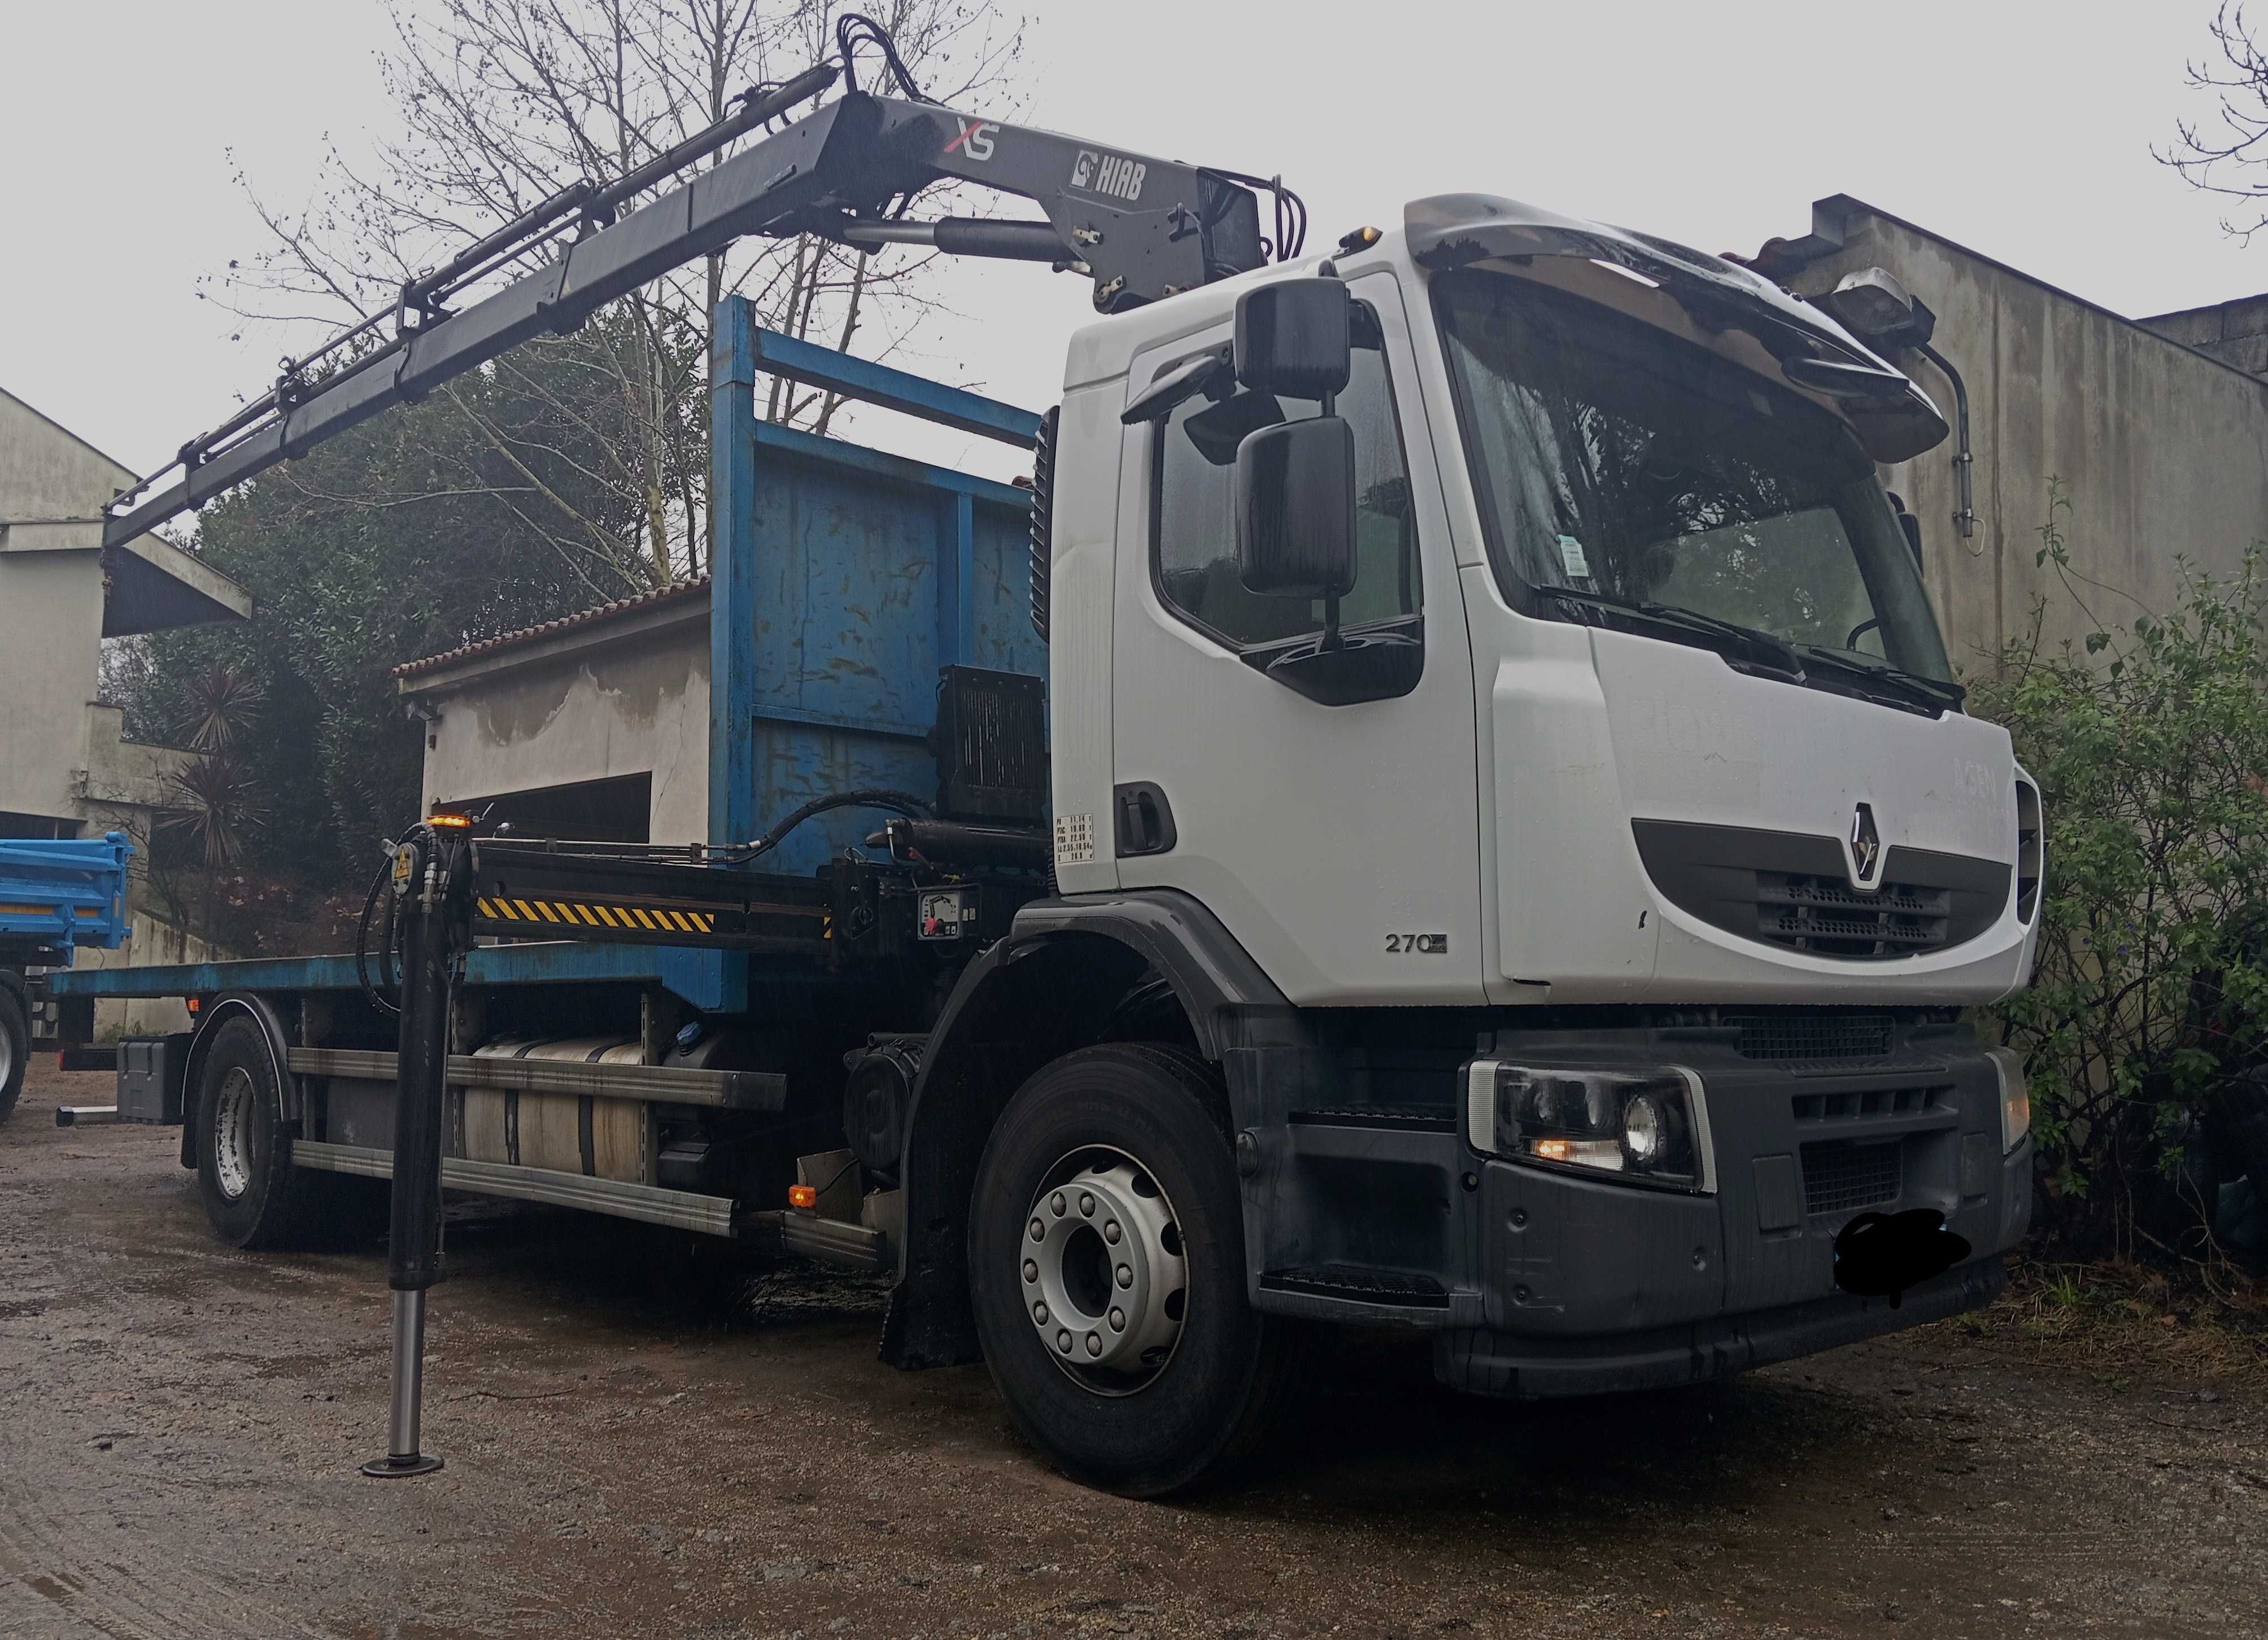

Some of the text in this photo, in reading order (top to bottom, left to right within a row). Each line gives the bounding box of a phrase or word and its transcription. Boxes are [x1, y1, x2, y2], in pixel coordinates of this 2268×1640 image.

[944, 116, 1000, 161] XS
[1094, 154, 1147, 201] HIAB
[1385, 934, 1432, 953] 270
